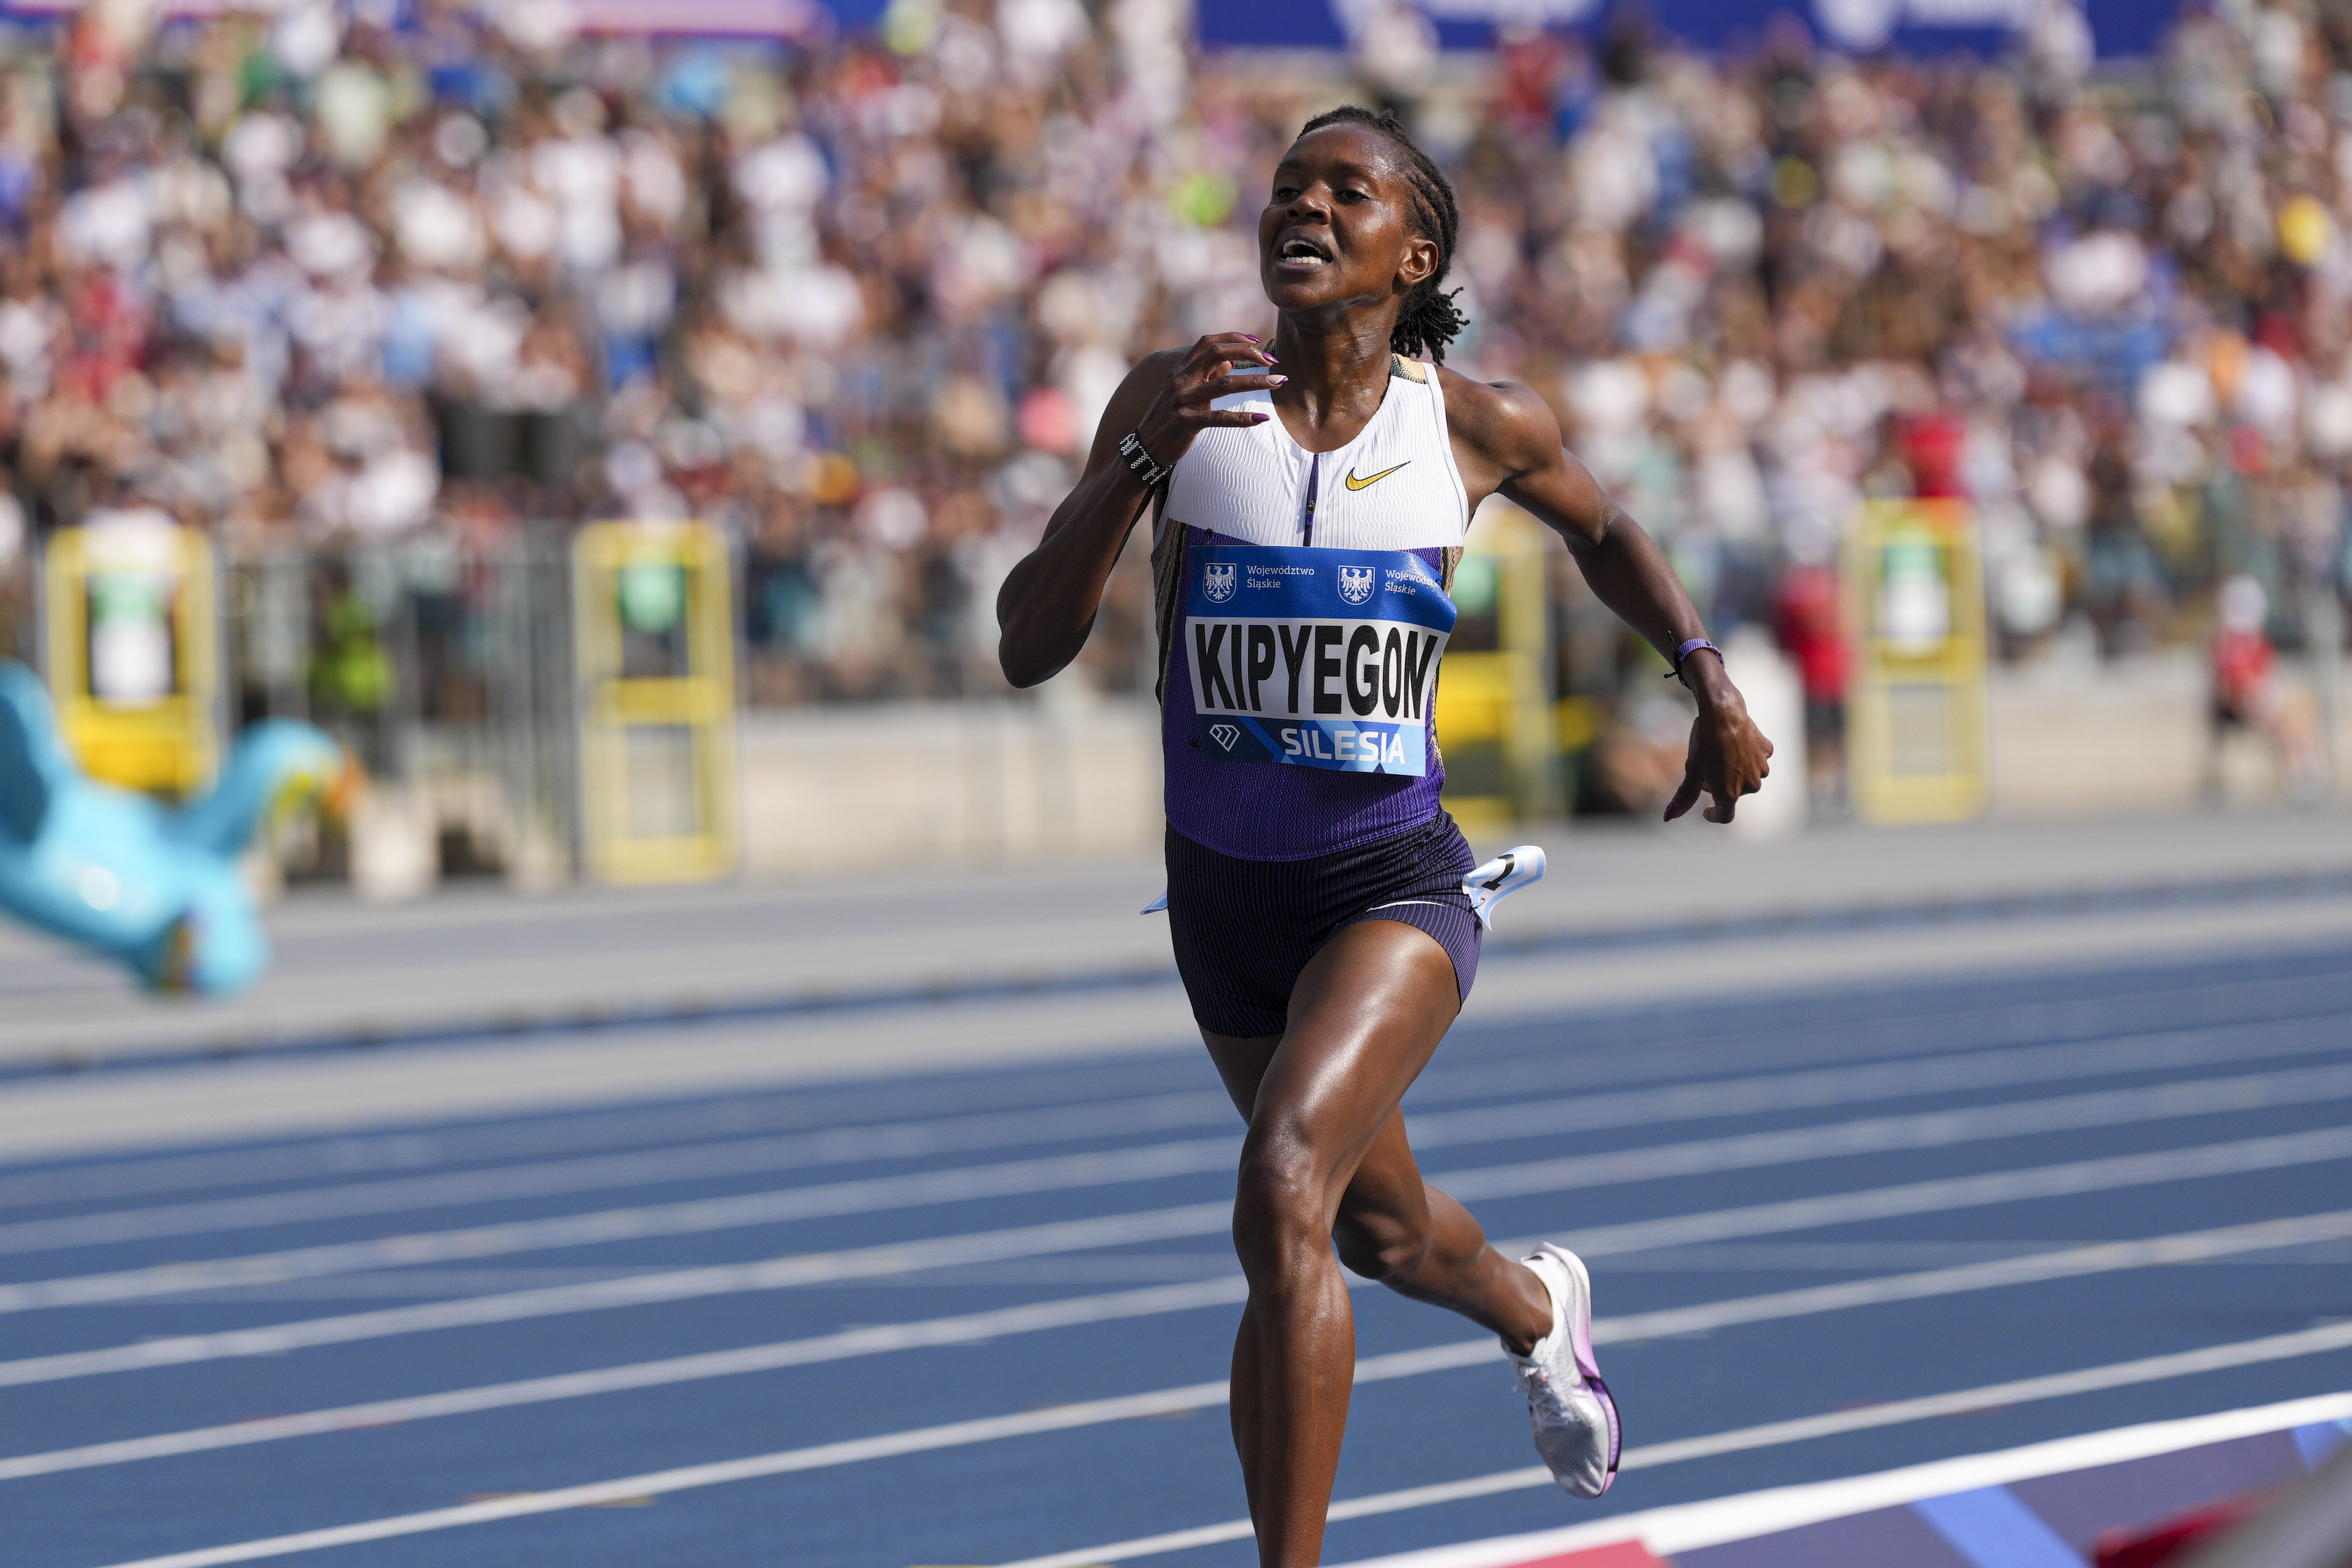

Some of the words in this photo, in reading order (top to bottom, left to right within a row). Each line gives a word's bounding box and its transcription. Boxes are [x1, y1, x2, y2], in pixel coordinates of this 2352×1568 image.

[1246, 565, 1315, 577] Województwo
[1246, 576, 1282, 590] Śląskie
[1384, 579, 1416, 595] Śląskie
[1195, 623, 1438, 720] KIPYEGON
[1281, 728, 1406, 765] SILESIA
